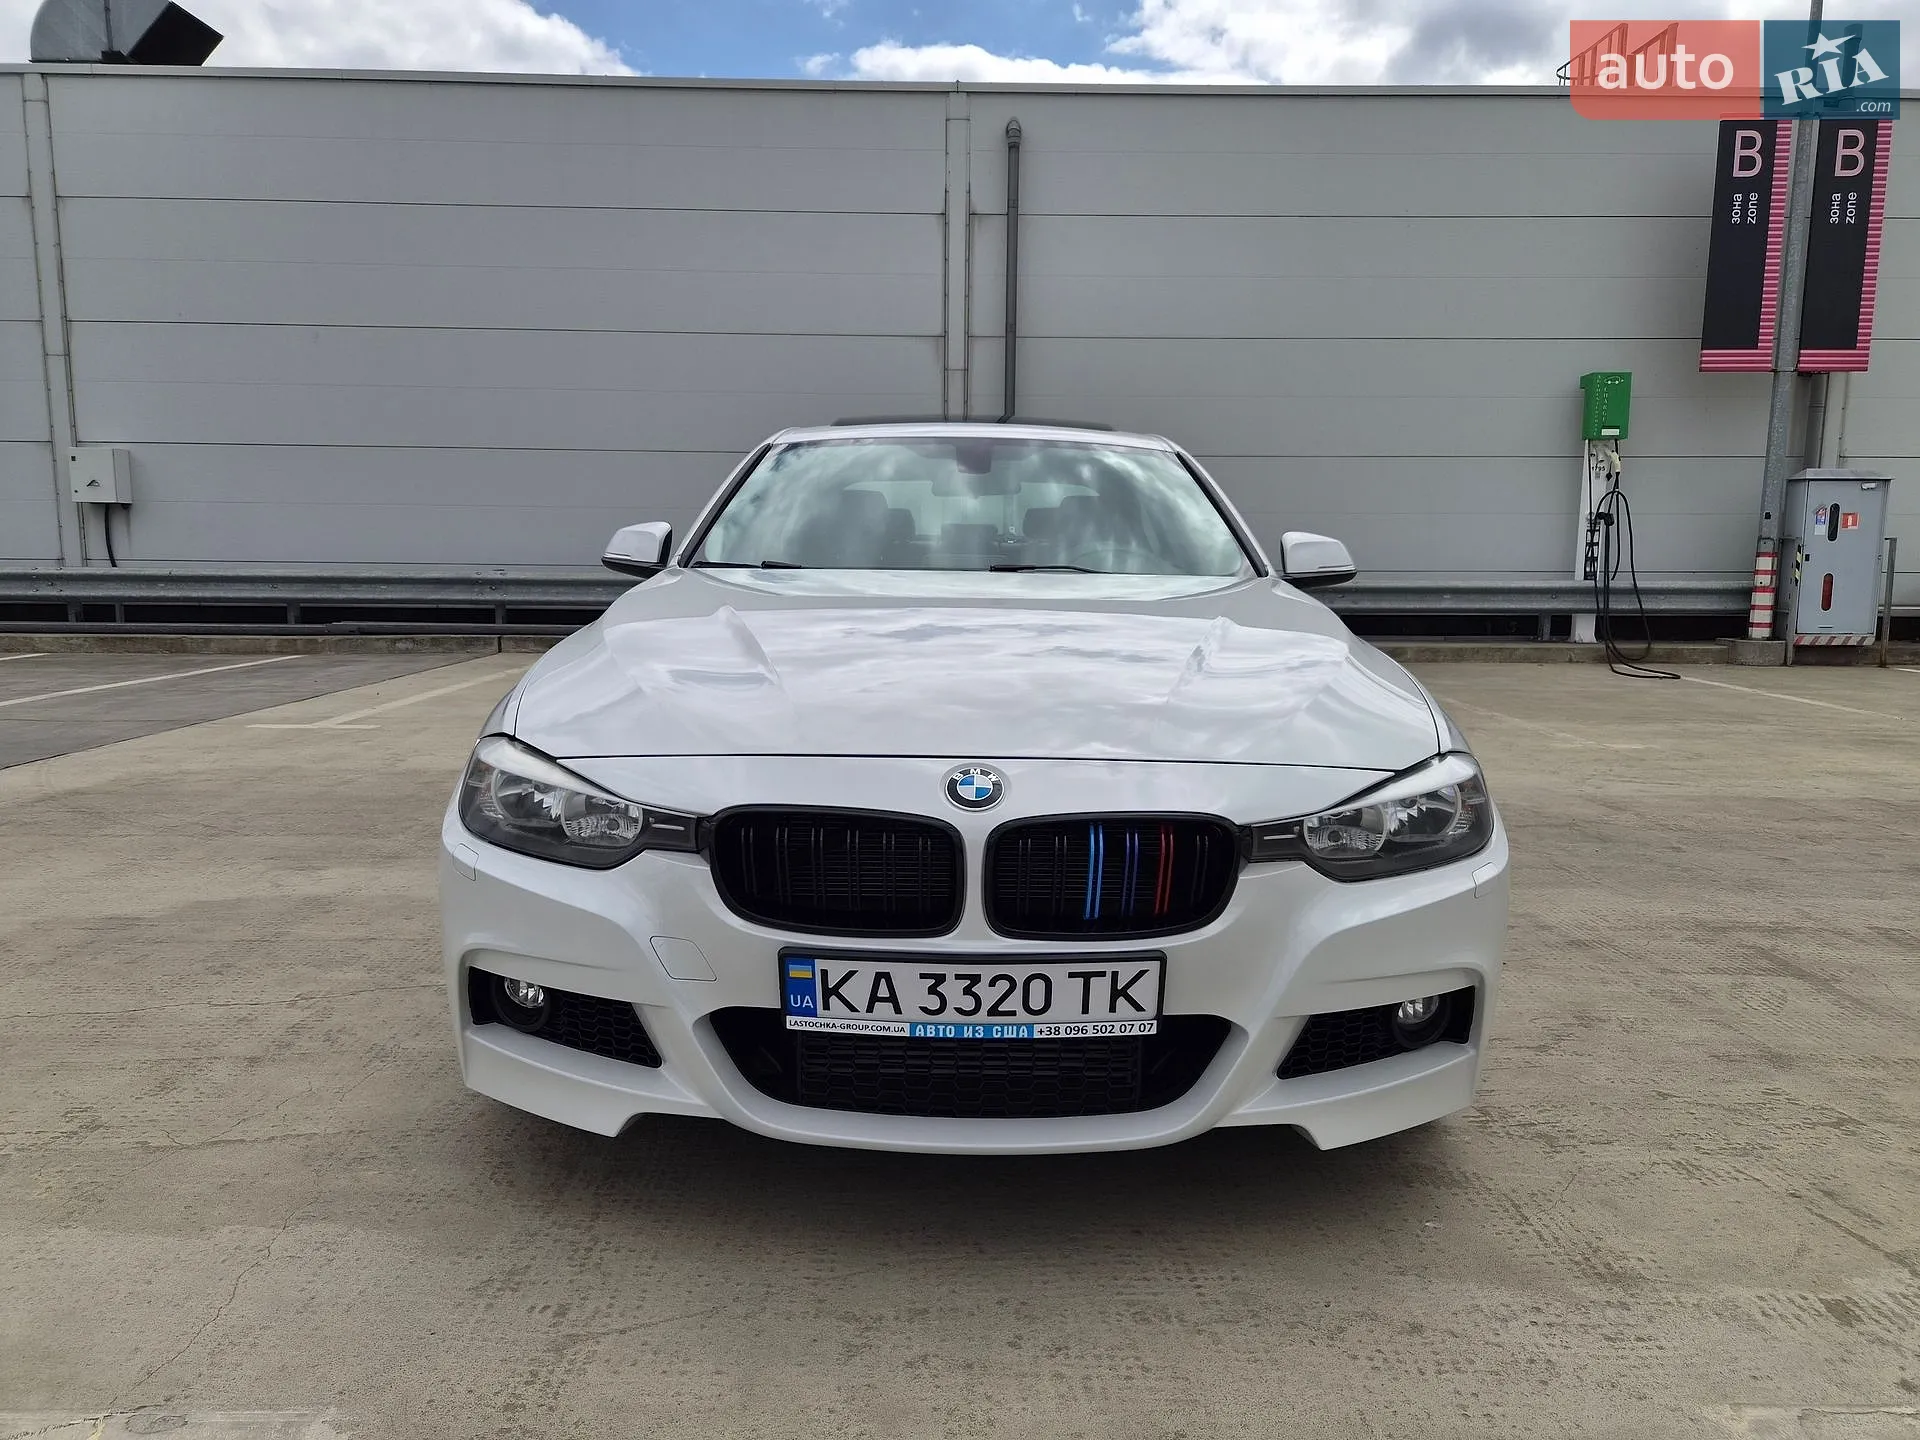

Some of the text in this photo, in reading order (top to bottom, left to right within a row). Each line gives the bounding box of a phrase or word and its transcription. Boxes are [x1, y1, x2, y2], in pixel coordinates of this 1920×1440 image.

[1732, 130, 1763, 178] B
[1834, 129, 1865, 177] B
[1732, 193, 1743, 224] зона
[1747, 192, 1758, 224] zone
[1830, 193, 1841, 224] зона
[1846, 192, 1857, 224] zone
[953, 768, 999, 782] BMW
[790, 994, 814, 1009] UA
[820, 968, 1151, 1017] KA 3320 TK
[789, 1020, 906, 1033] LASTOCHKA-GROUP.COM.UA
[915, 1025, 1028, 1038] АВТО ИЗ США
[1037, 1022, 1154, 1036] +38 096 502 07 07
